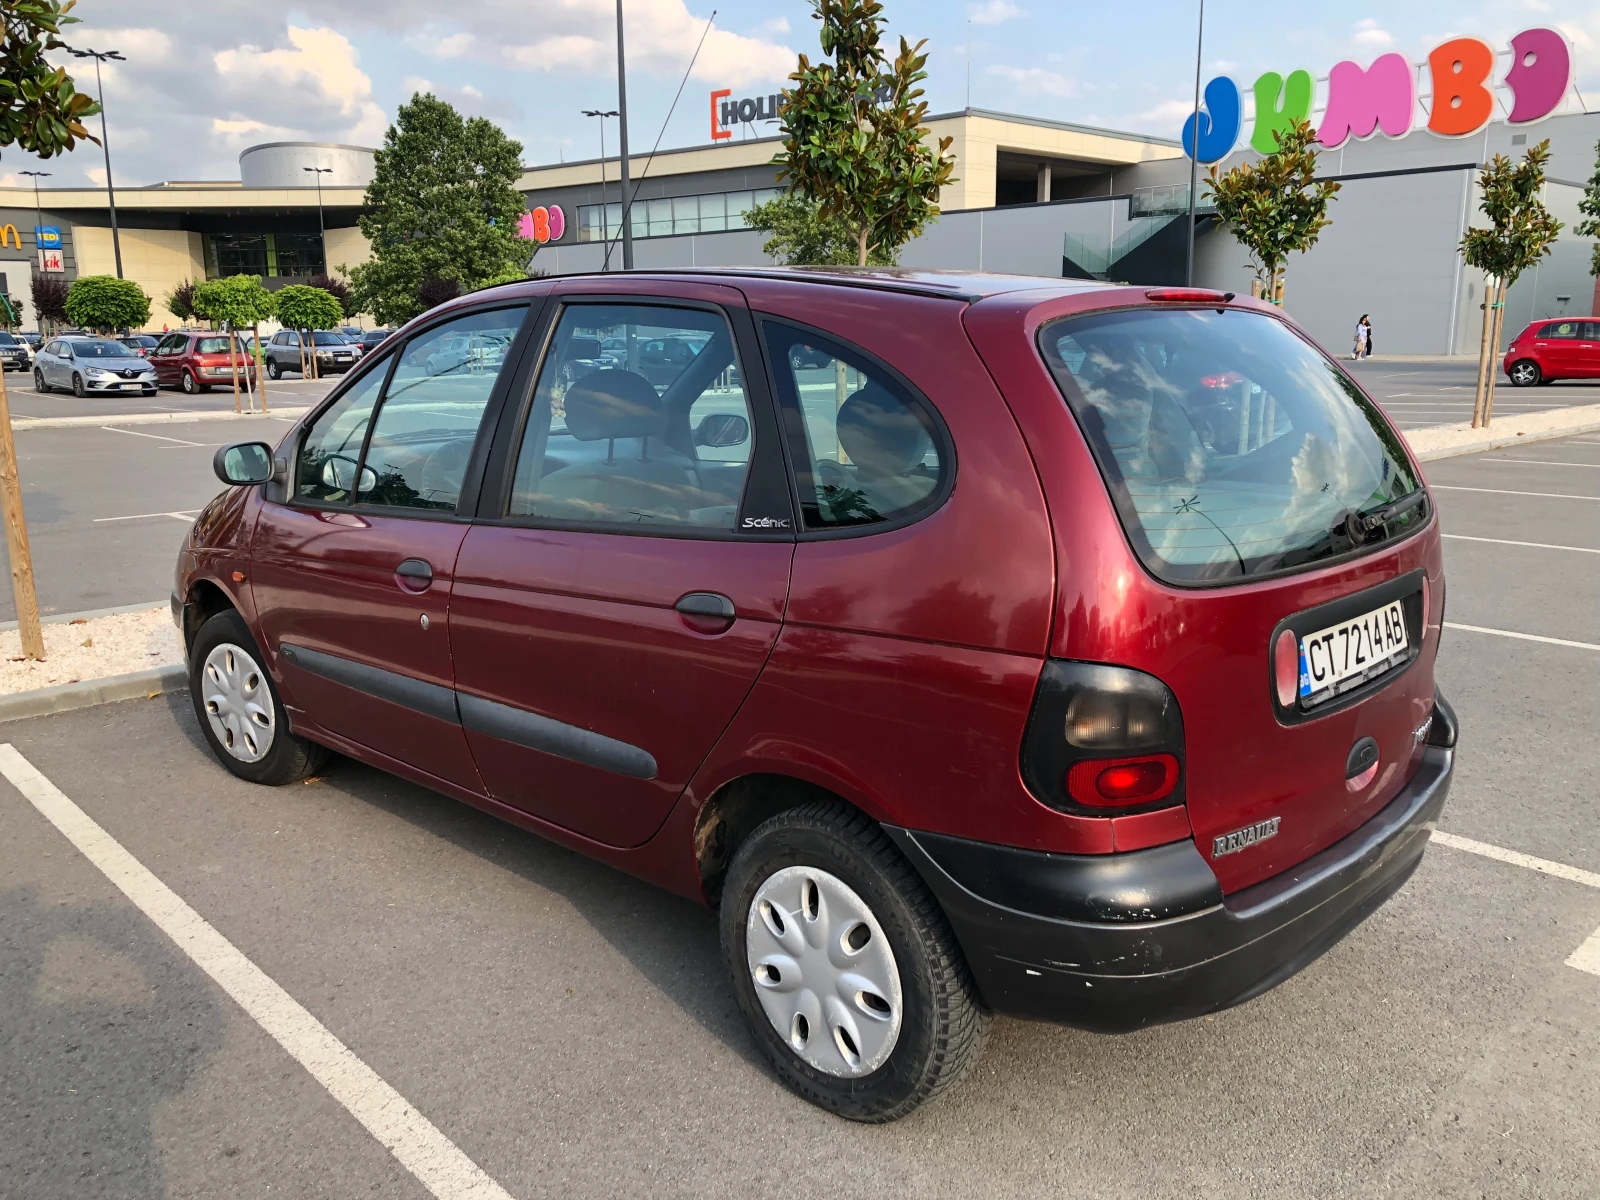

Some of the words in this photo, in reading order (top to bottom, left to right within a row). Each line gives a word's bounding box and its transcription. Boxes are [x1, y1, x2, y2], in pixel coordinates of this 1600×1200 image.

[1182, 28, 1569, 163] JUMBO
[742, 516, 790, 529] Scénic
[1212, 816, 1281, 858] RENAULT
